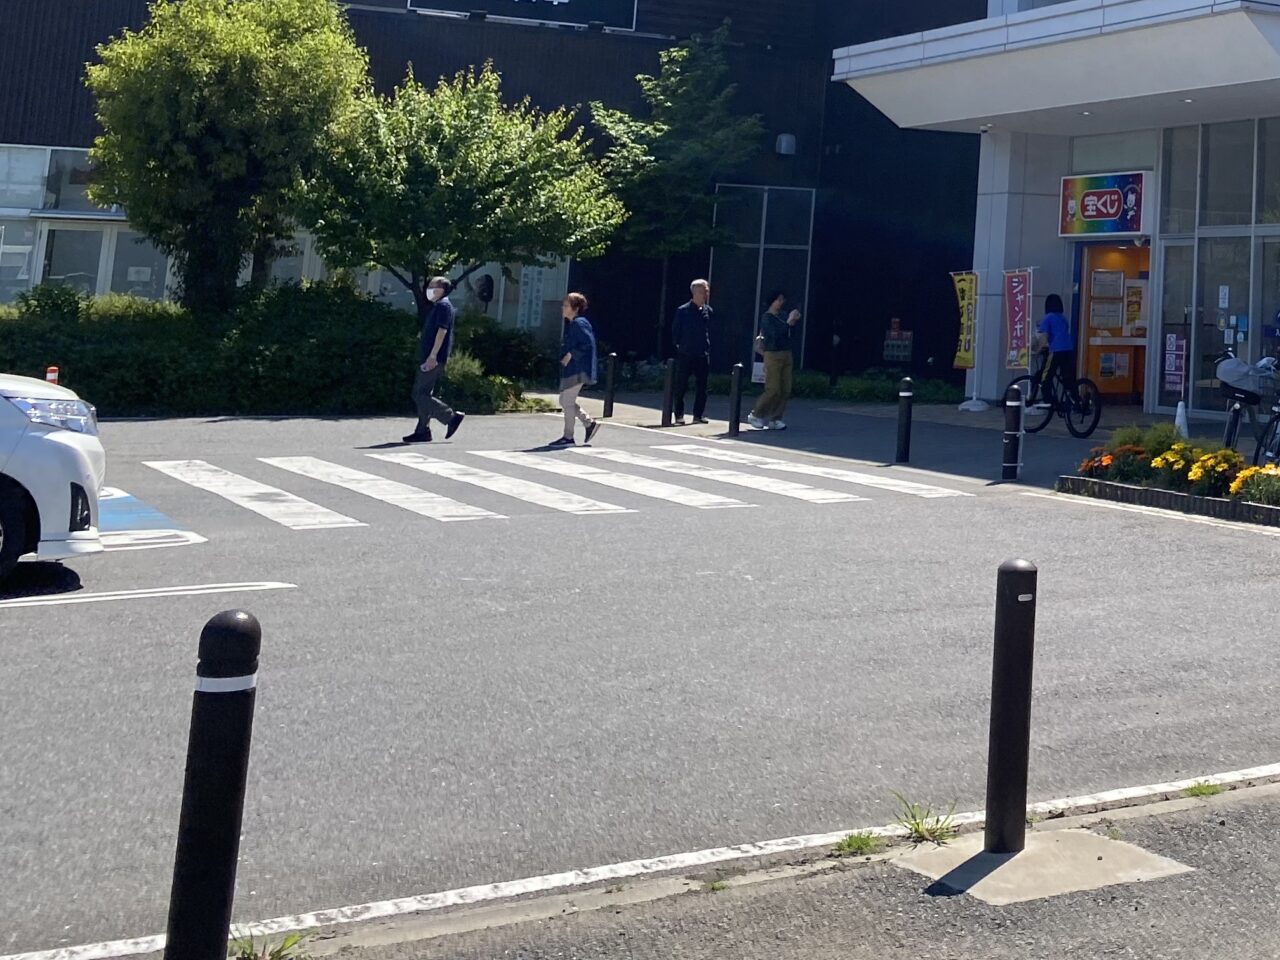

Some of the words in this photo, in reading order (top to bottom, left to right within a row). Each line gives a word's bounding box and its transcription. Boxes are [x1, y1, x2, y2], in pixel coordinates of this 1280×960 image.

[1084, 194, 1119, 216] 宝くじ
[1011, 277, 1024, 337] ジャンボ
